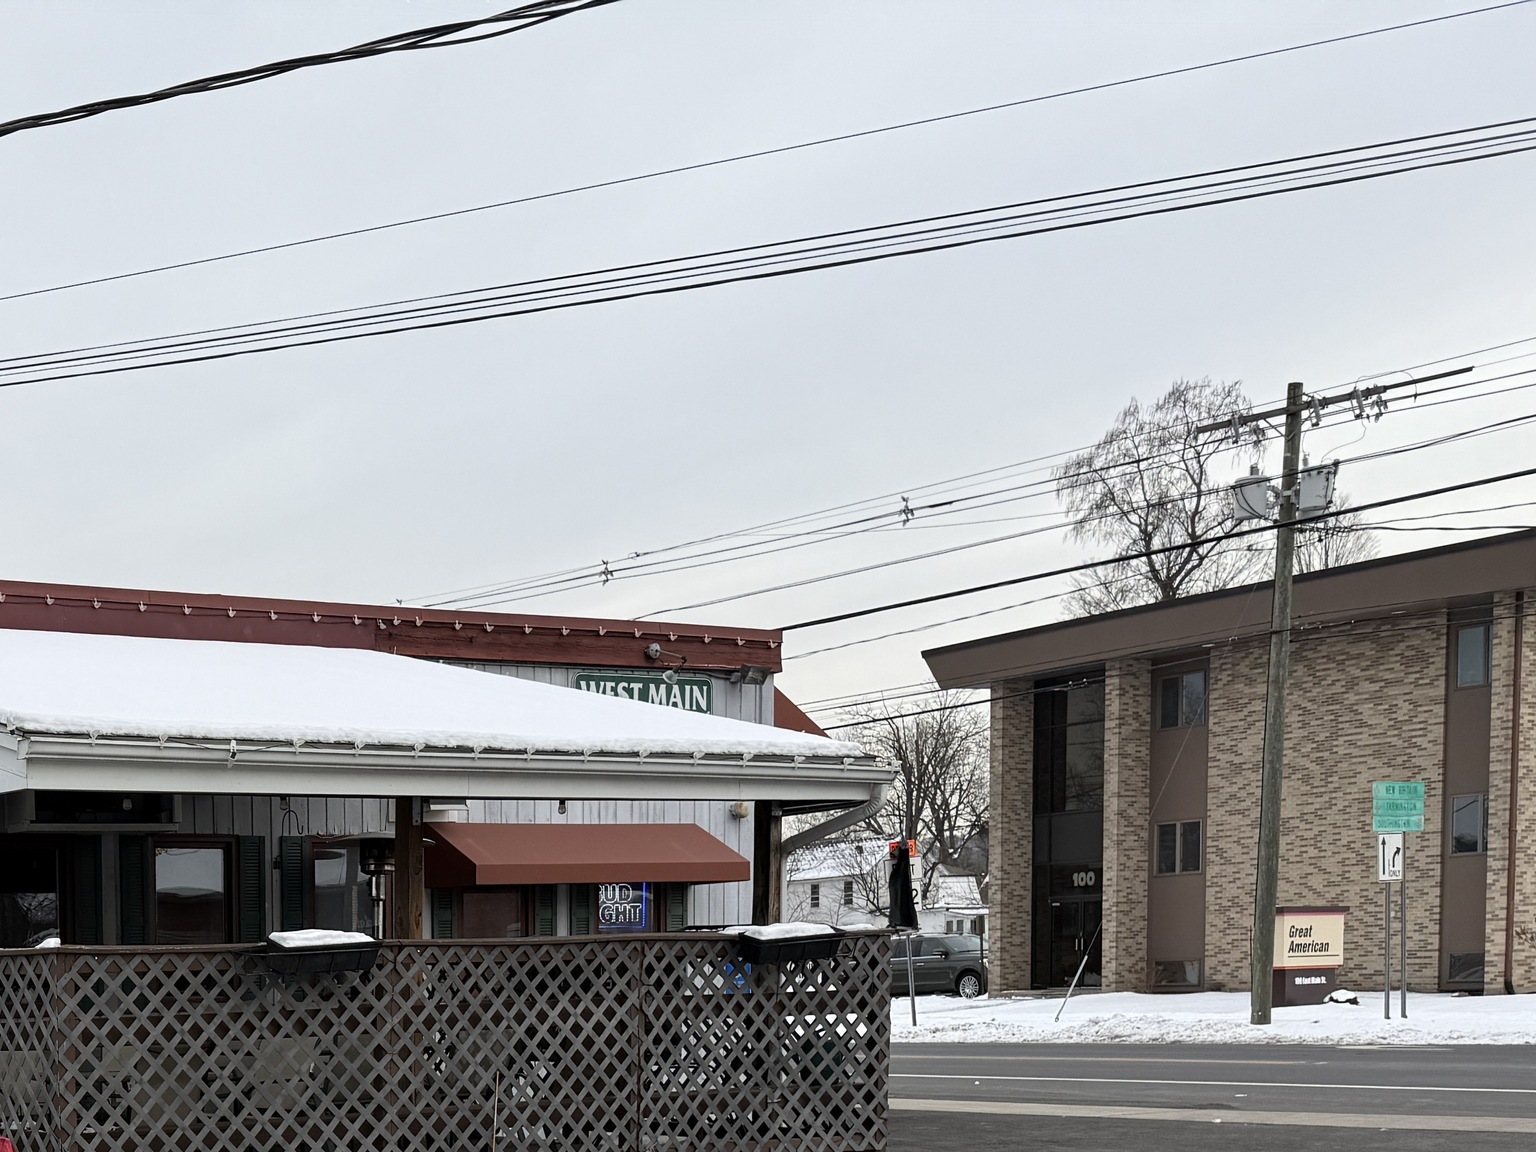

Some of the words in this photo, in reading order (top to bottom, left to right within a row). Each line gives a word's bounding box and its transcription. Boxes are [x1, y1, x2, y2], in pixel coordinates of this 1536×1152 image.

[648, 683, 707, 711] MAIN
[1072, 871, 1095, 887] 100
[1289, 925, 1312, 938] Great
[1287, 940, 1330, 953] American
